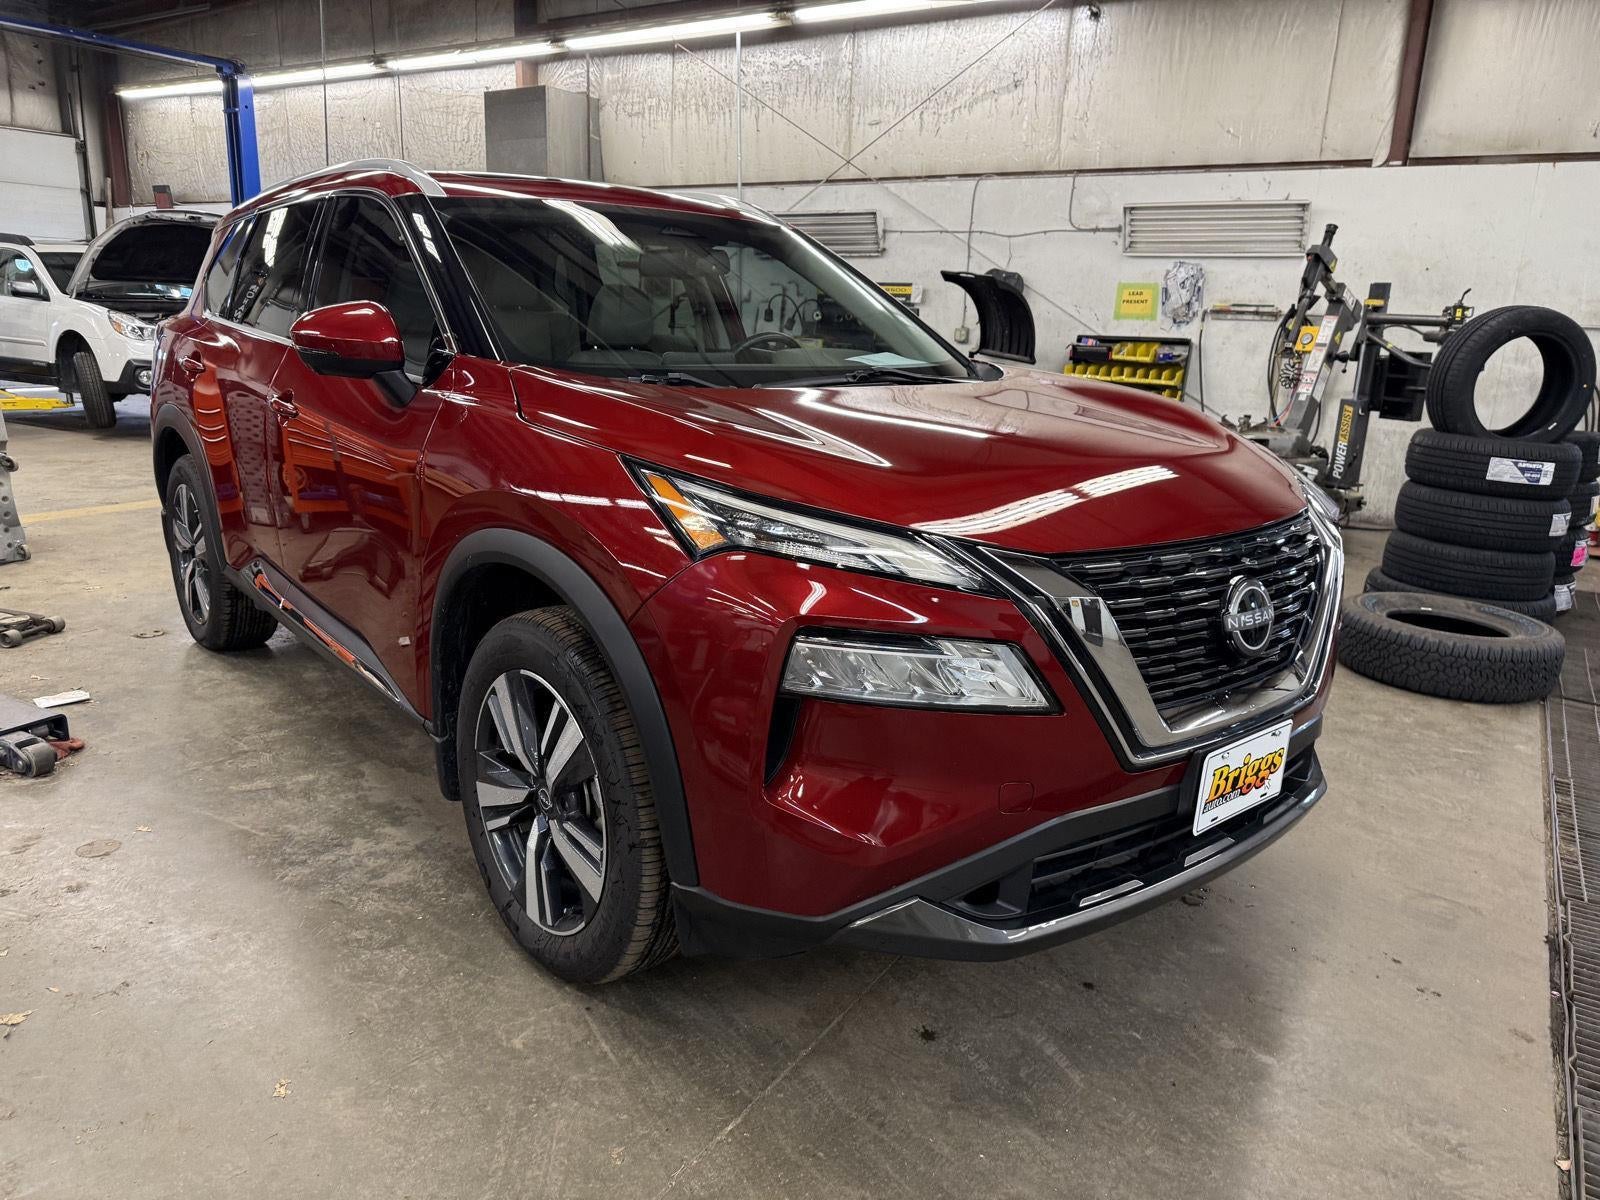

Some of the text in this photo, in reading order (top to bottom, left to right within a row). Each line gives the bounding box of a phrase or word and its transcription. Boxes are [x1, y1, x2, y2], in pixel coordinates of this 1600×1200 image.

[1332, 407, 1352, 479] POWER ASSIST
[1227, 608, 1274, 629] NISSAN
[1205, 747, 1285, 803] Briggs
